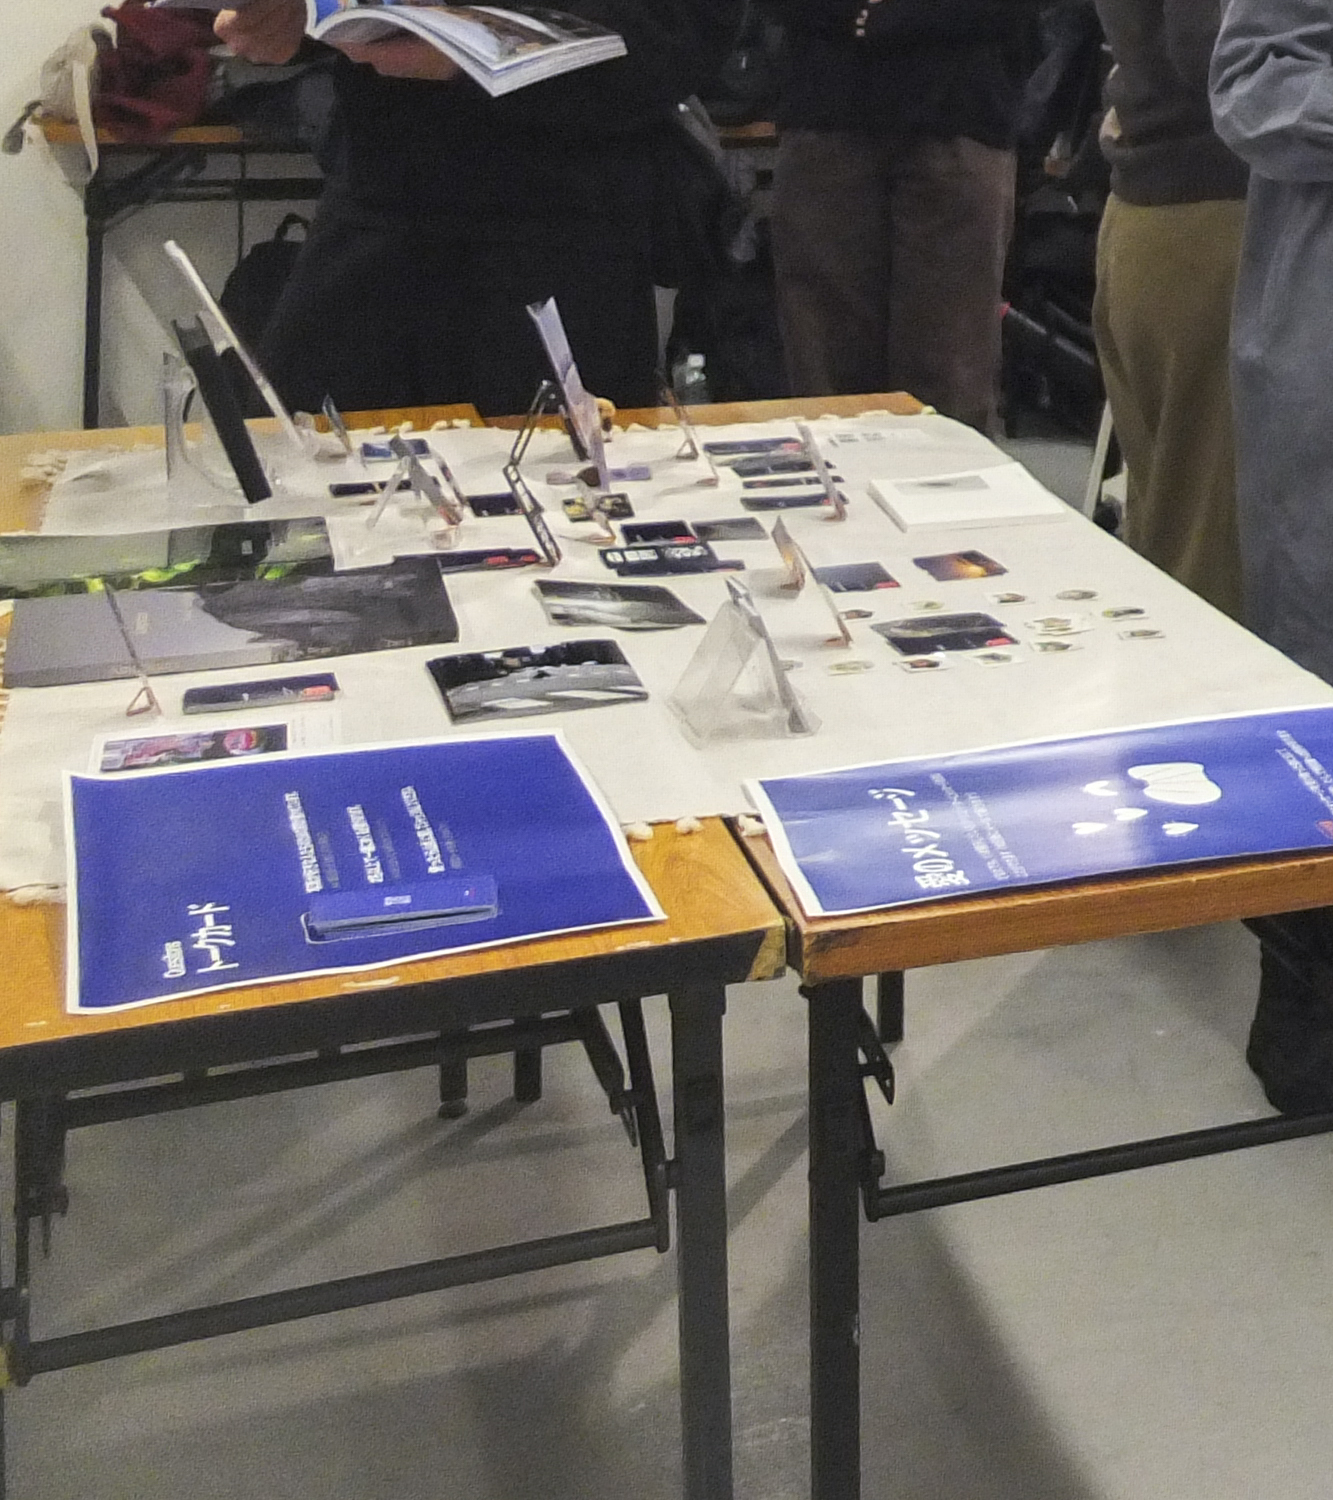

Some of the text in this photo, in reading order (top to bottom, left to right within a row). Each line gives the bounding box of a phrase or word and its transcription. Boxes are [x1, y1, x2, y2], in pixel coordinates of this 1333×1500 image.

[868, 788, 970, 888] 愛のメッセージ
[187, 902, 240, 974] トークカード
